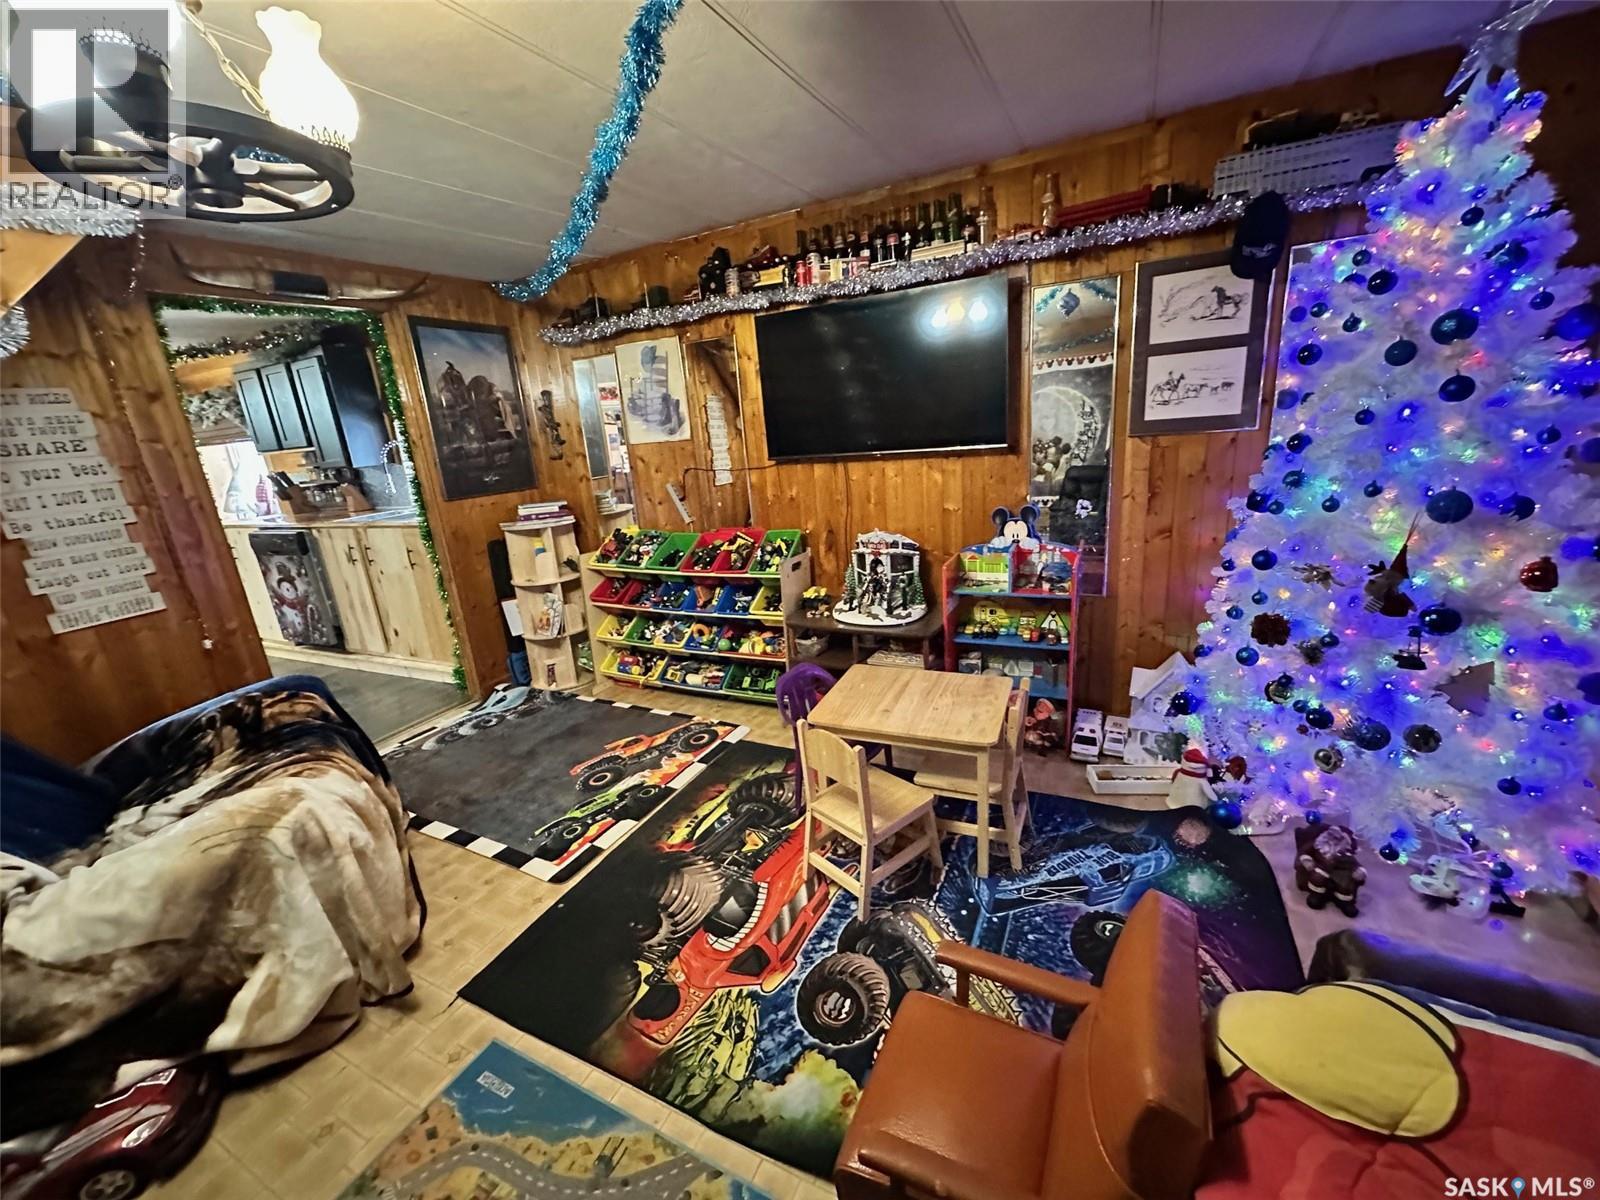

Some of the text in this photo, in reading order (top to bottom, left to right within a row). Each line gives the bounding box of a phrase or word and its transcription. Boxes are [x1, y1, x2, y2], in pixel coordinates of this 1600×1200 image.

[27, 425, 78, 436] TRUTH
[43, 414, 84, 425] TELL
[0, 439, 87, 458] SHARE
[19, 468, 61, 487] your
[67, 462, 108, 477] best
[3, 487, 117, 512] SAY I LOVE YOU
[9, 509, 127, 535] Be thankful
[33, 546, 138, 571] LOVE EACH OTHER
[34, 561, 147, 588] Laugh out loud
[1044, 850, 1094, 877] THUNDER
[1092, 850, 1122, 867] BLUE
